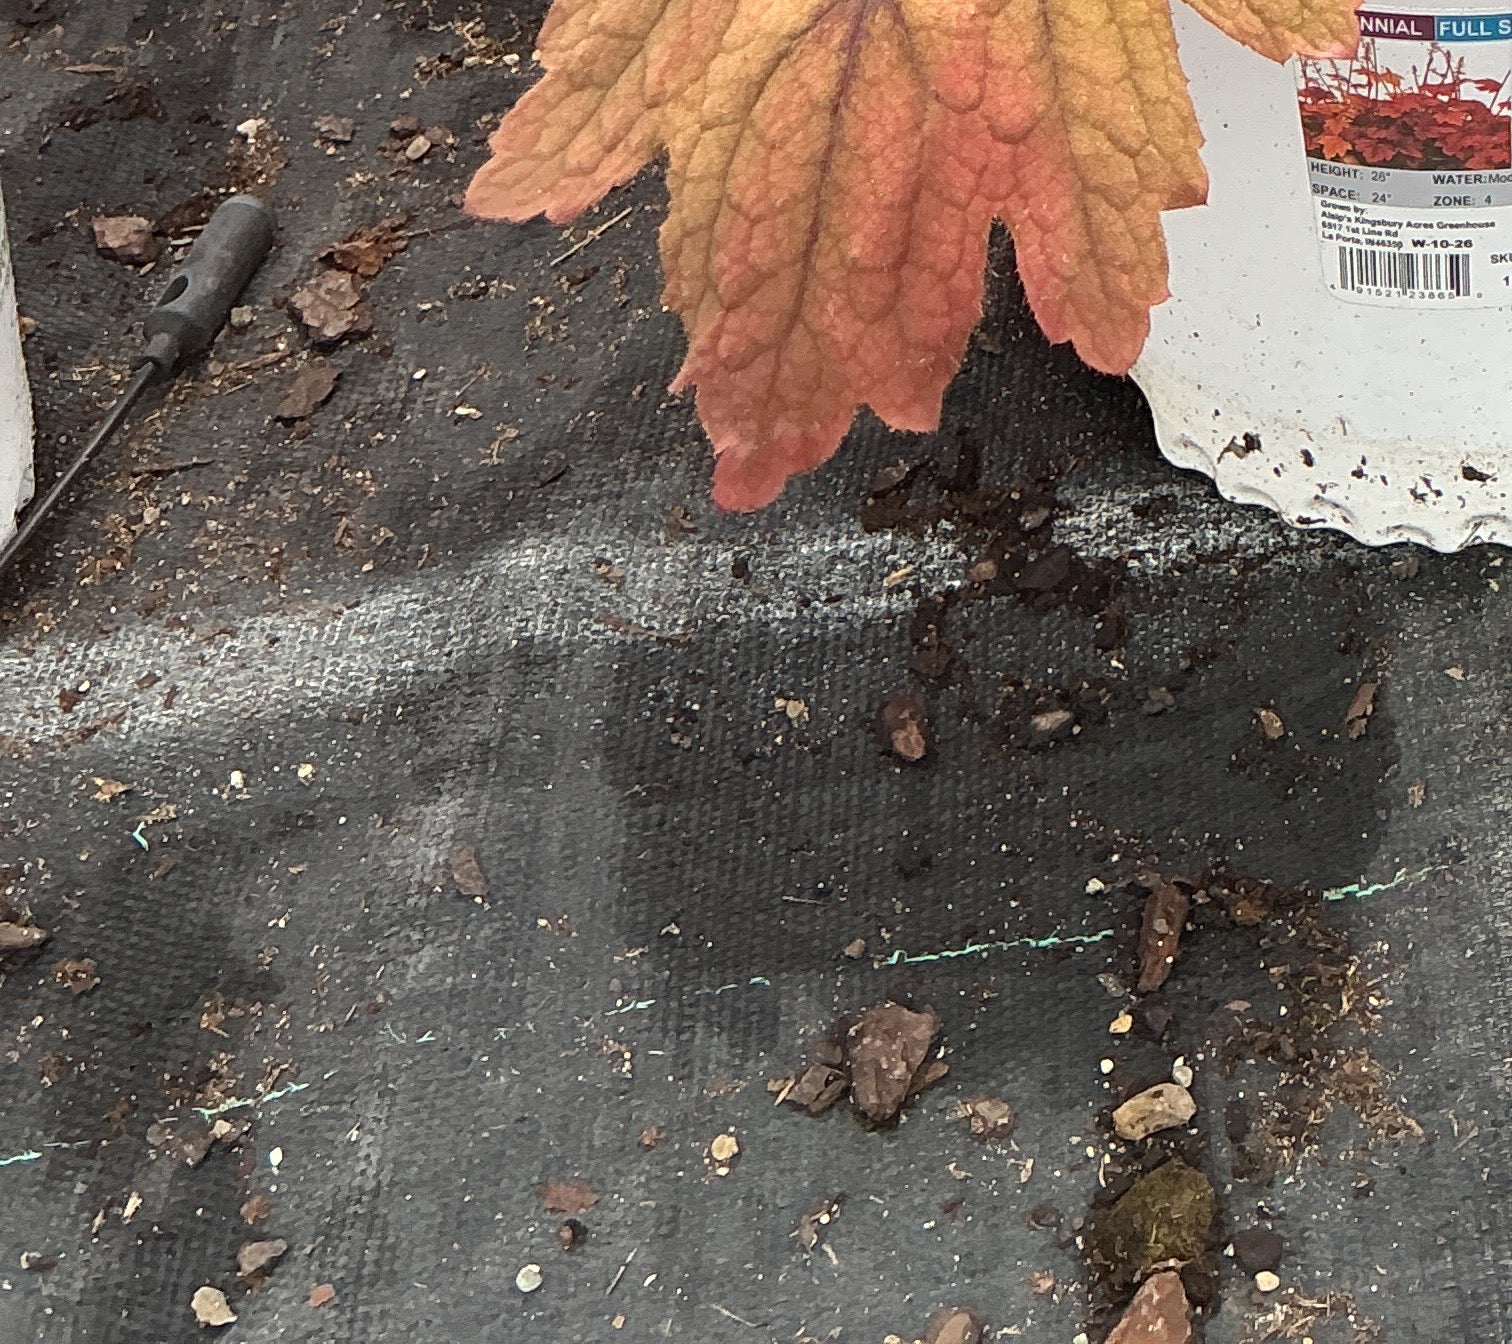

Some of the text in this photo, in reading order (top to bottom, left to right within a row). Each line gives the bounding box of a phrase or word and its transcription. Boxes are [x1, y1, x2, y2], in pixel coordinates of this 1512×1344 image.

[1359, 16, 1423, 36] NNIAL
[1439, 21, 1492, 37] FULL
[1311, 162, 1363, 181] HEIGHT:
[1311, 183, 1361, 201] SPACE:
[1320, 199, 1351, 212] Grown
[1433, 194, 1492, 207] ZONE: 4
[1354, 216, 1404, 230] Kingsbury
[1405, 221, 1434, 230] Acres
[1436, 220, 1496, 230] Greenhouse
[1321, 231, 1334, 240] La
[1346, 225, 1361, 235] 1st
[1362, 227, 1383, 237] Line
[1385, 229, 1399, 238] Rd
[1411, 239, 1474, 249] W-10-26
[1503, 274, 1510, 287] 1
